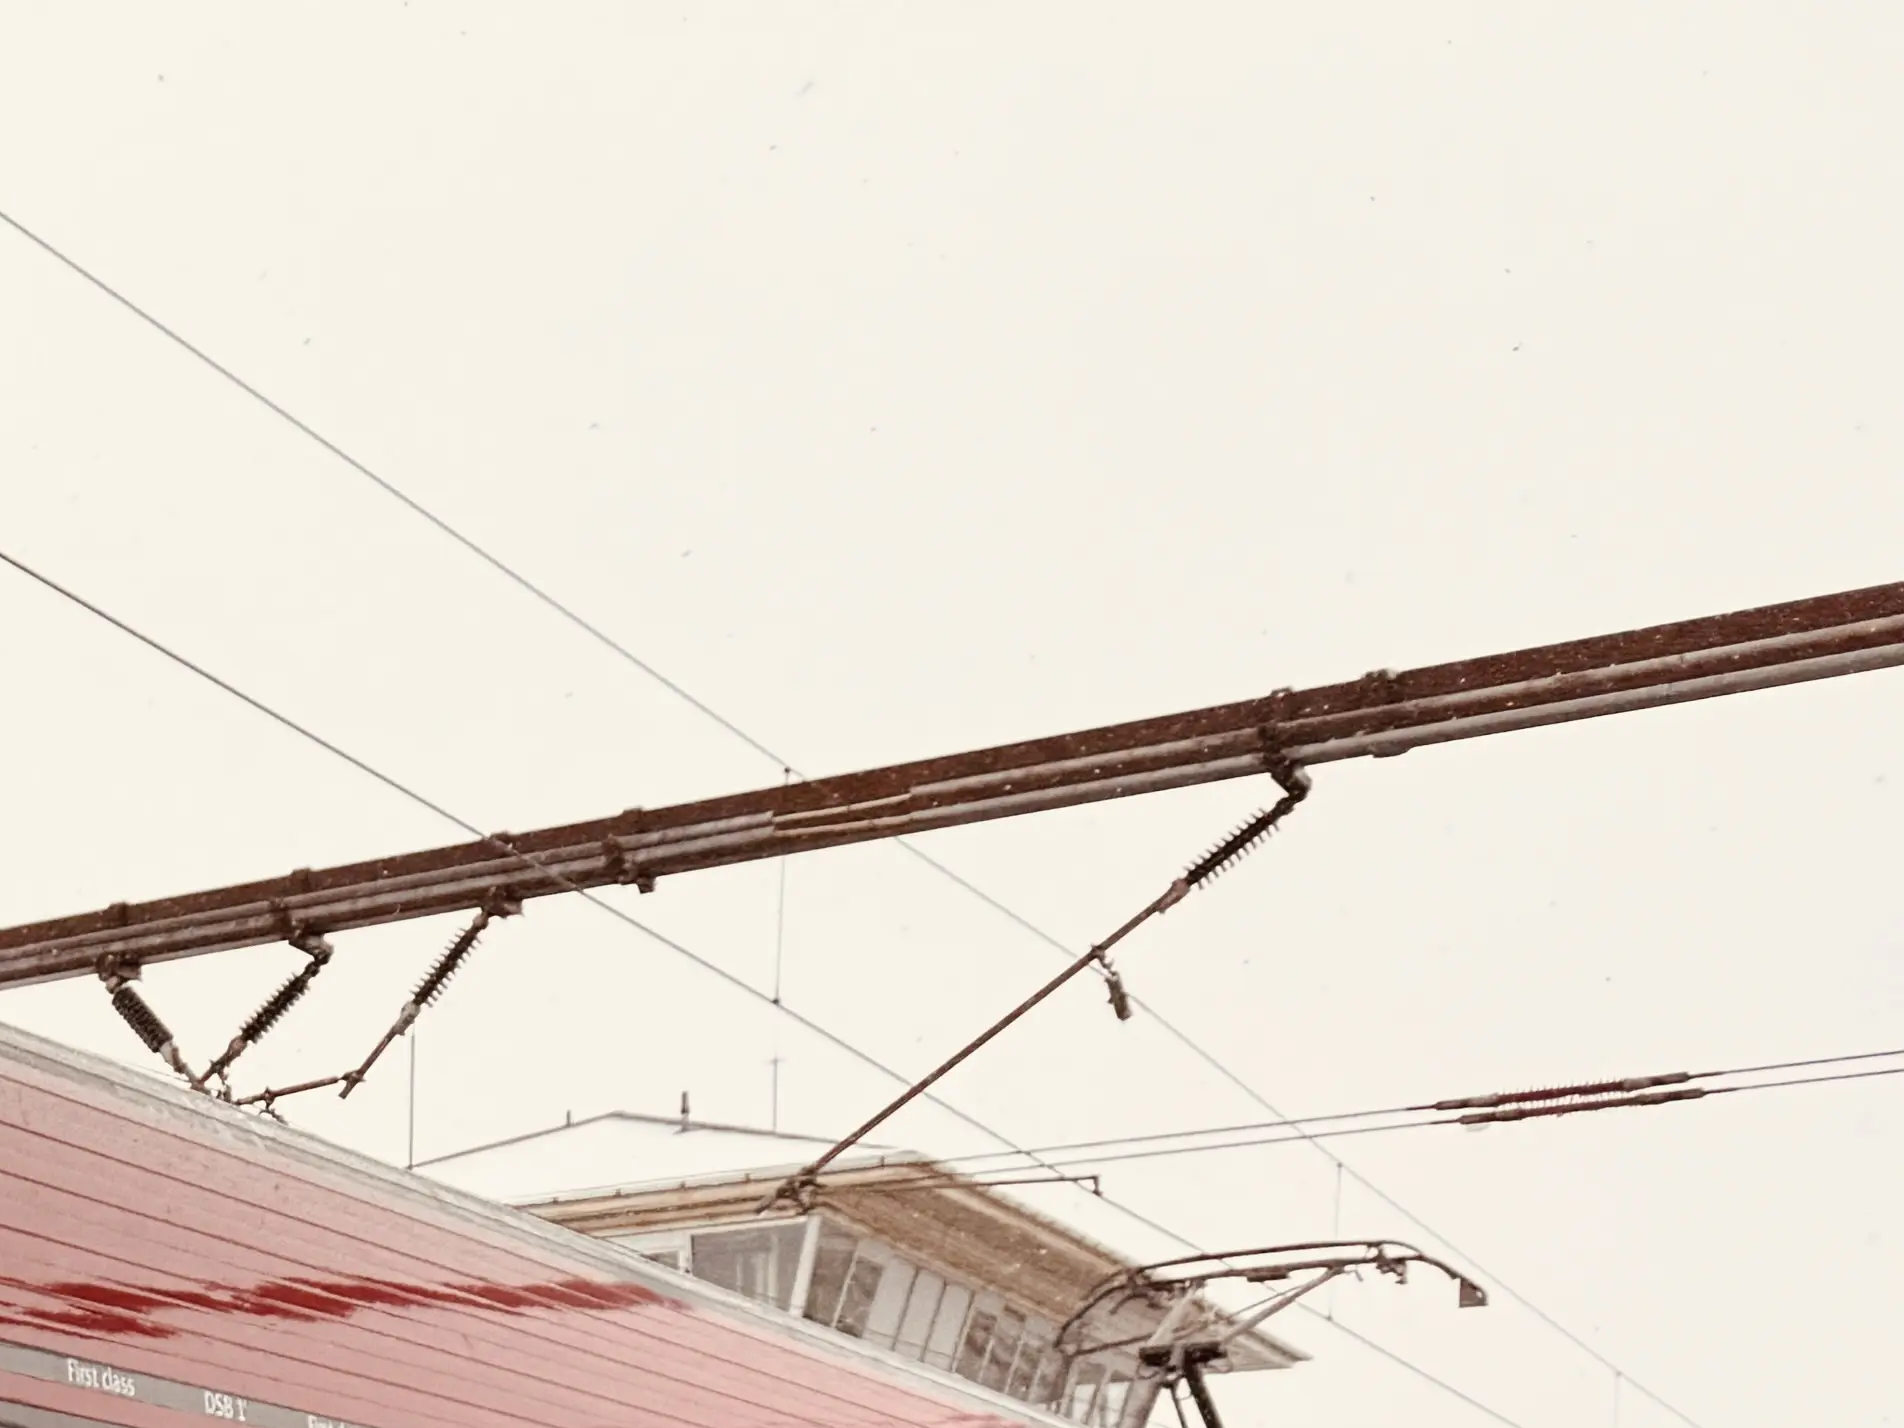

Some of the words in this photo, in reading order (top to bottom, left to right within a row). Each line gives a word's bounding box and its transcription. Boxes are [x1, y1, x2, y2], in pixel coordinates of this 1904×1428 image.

[67, 1358, 100, 1389] First
[102, 1366, 136, 1397] class
[204, 1390, 234, 1419] DSB
